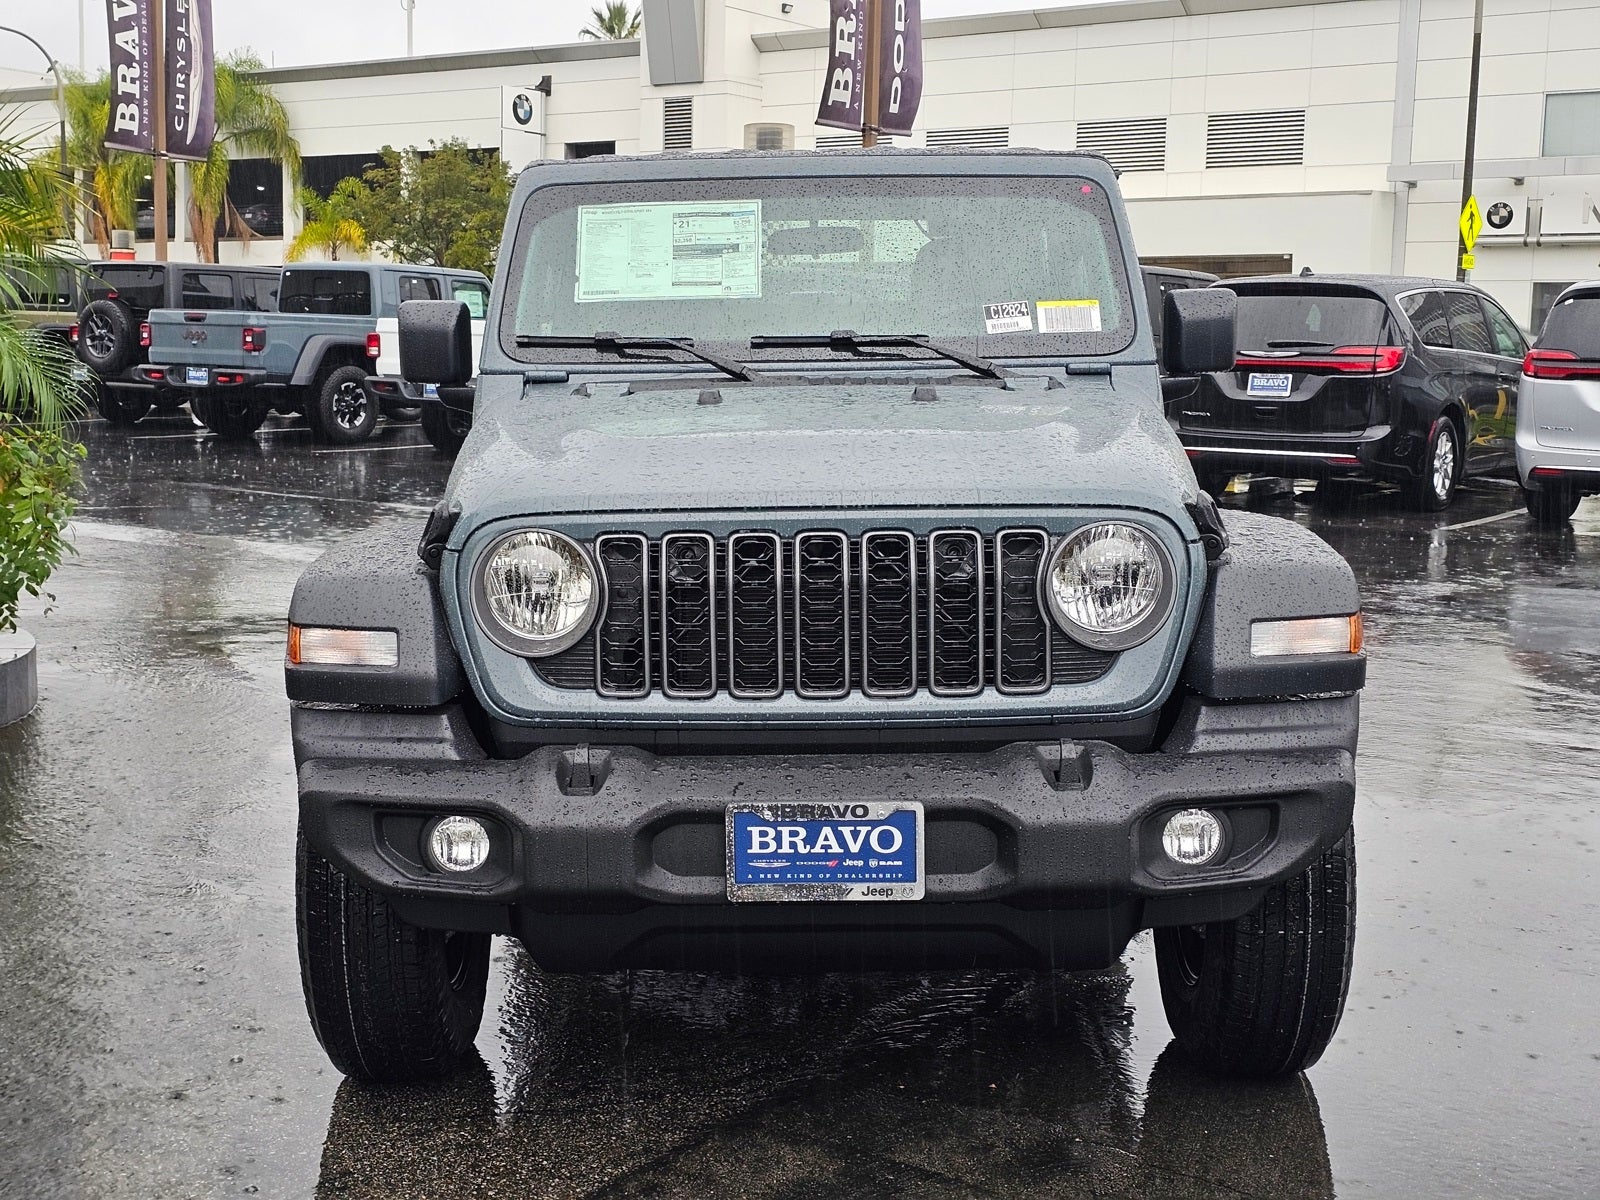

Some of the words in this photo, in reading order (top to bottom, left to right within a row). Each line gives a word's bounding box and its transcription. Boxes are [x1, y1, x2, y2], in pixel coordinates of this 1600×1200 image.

[140, 0, 148, 34] DEAL
[142, 41, 148, 56] OF
[827, 0, 857, 109] BR
[853, 102, 859, 110] A
[678, 220, 690, 229] 21
[990, 302, 1028, 319] C12824
[1253, 378, 1288, 387] BRAVO
[780, 804, 869, 819] BRAVO
[746, 825, 903, 854] BRAVO
[842, 858, 864, 867] Jeep
[861, 885, 894, 898] Jeep
